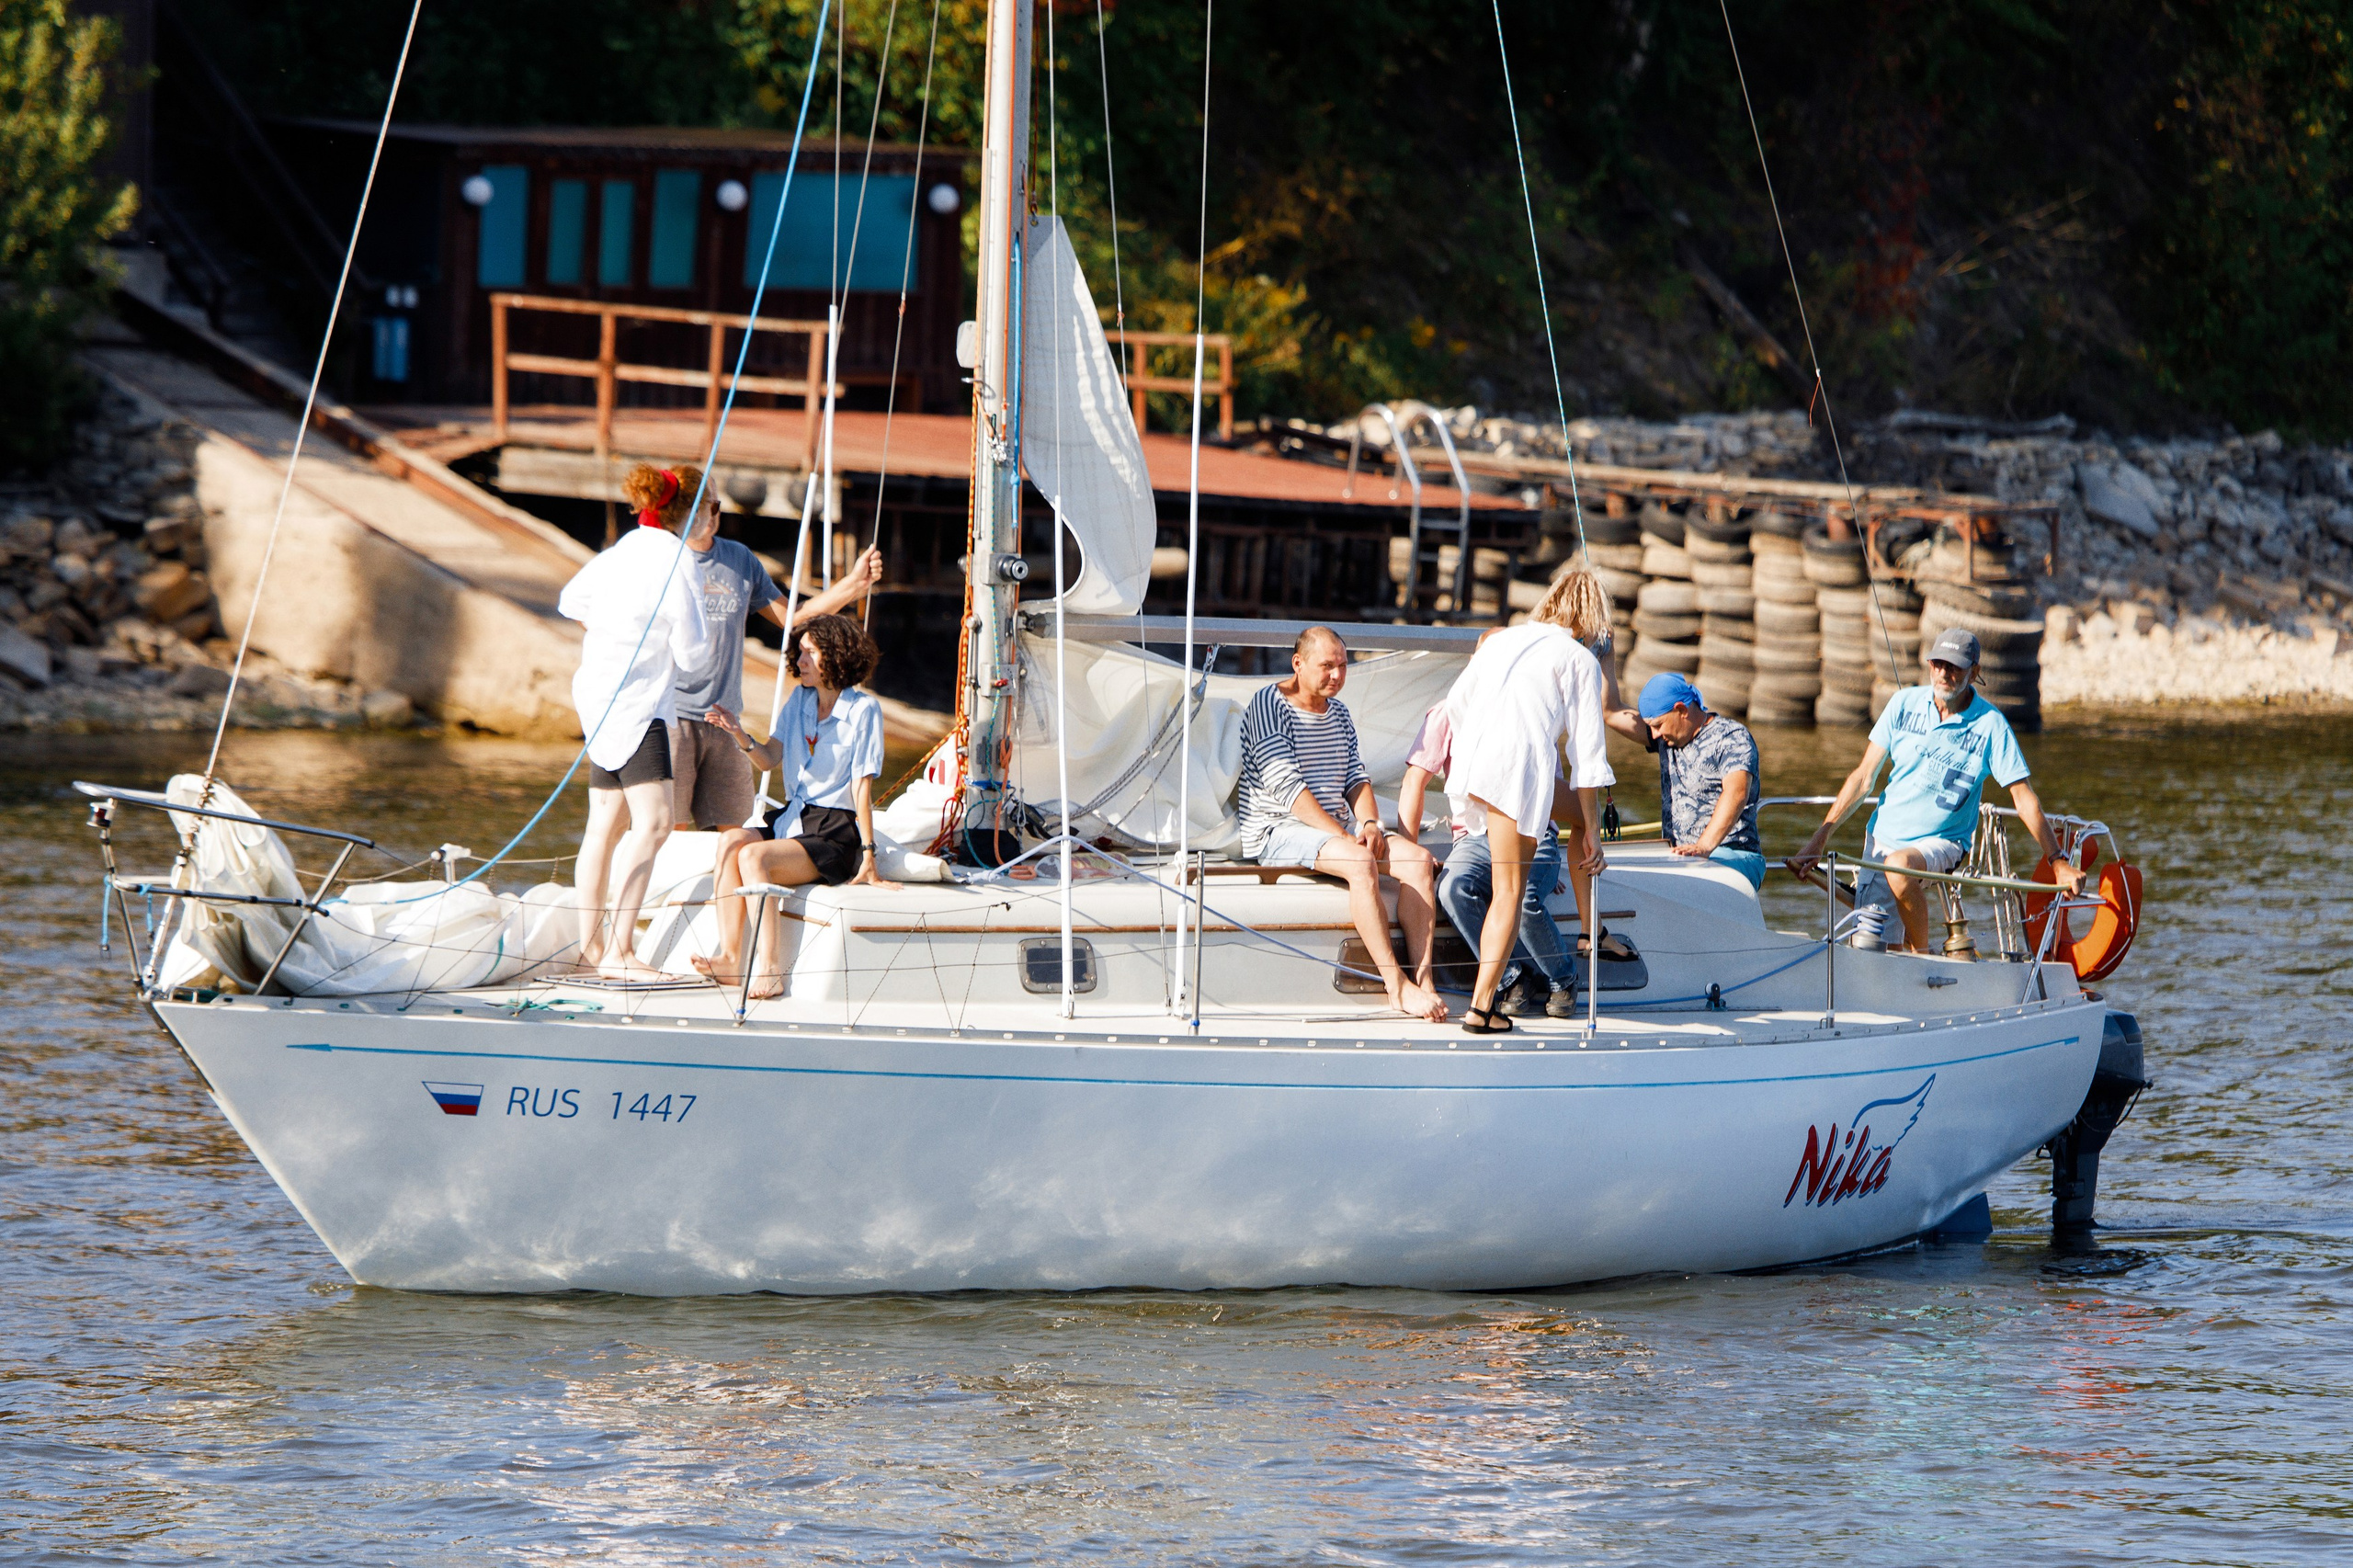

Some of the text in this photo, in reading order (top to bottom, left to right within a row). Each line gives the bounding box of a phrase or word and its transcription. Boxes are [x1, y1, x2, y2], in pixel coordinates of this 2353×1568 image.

[1935, 767, 1976, 812] 5
[506, 1086, 697, 1123] RUS 1447
[1783, 1122, 1893, 1209] Nika
